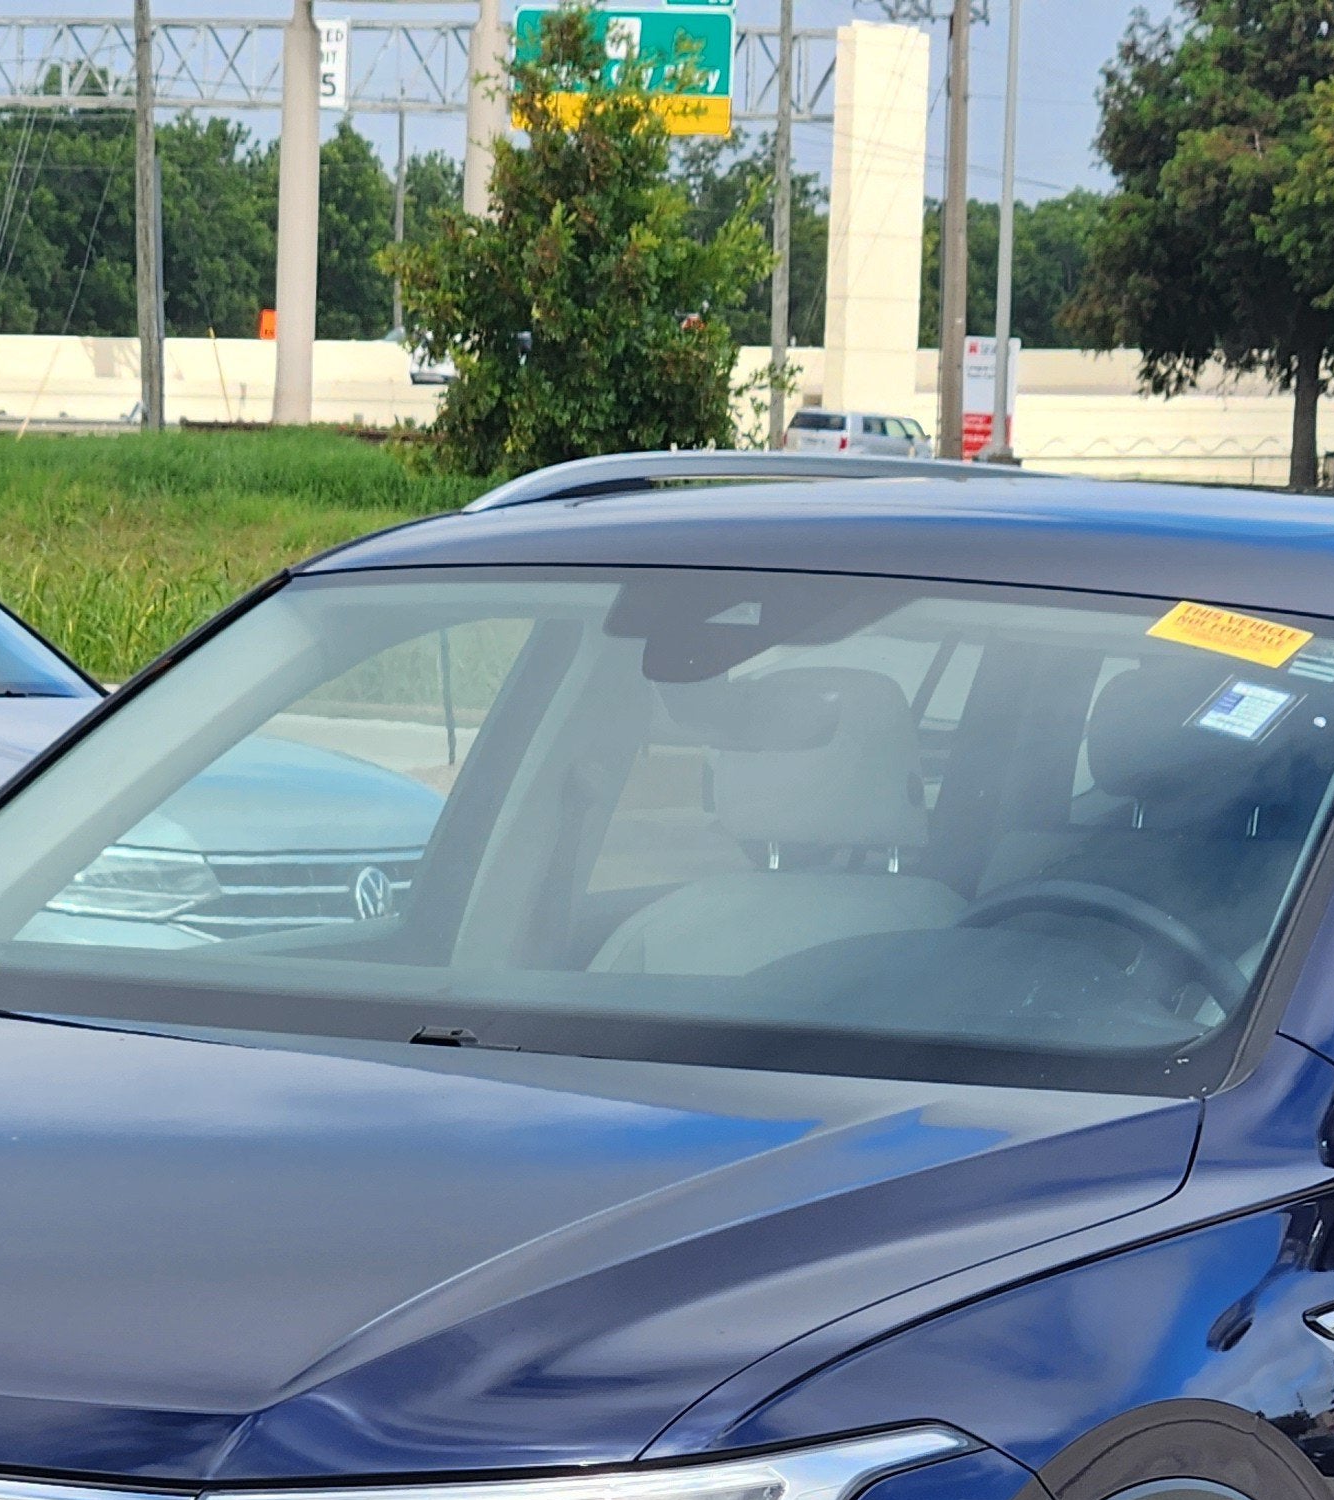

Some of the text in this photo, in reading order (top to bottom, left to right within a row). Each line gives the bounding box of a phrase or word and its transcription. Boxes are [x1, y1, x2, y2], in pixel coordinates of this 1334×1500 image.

[321, 72, 336, 97] 5
[1176, 614, 1206, 628] NOT
[1210, 621, 1243, 637] FOR
[1248, 631, 1286, 649] SALE
[1184, 605, 1303, 641] THIS VEHICLE
